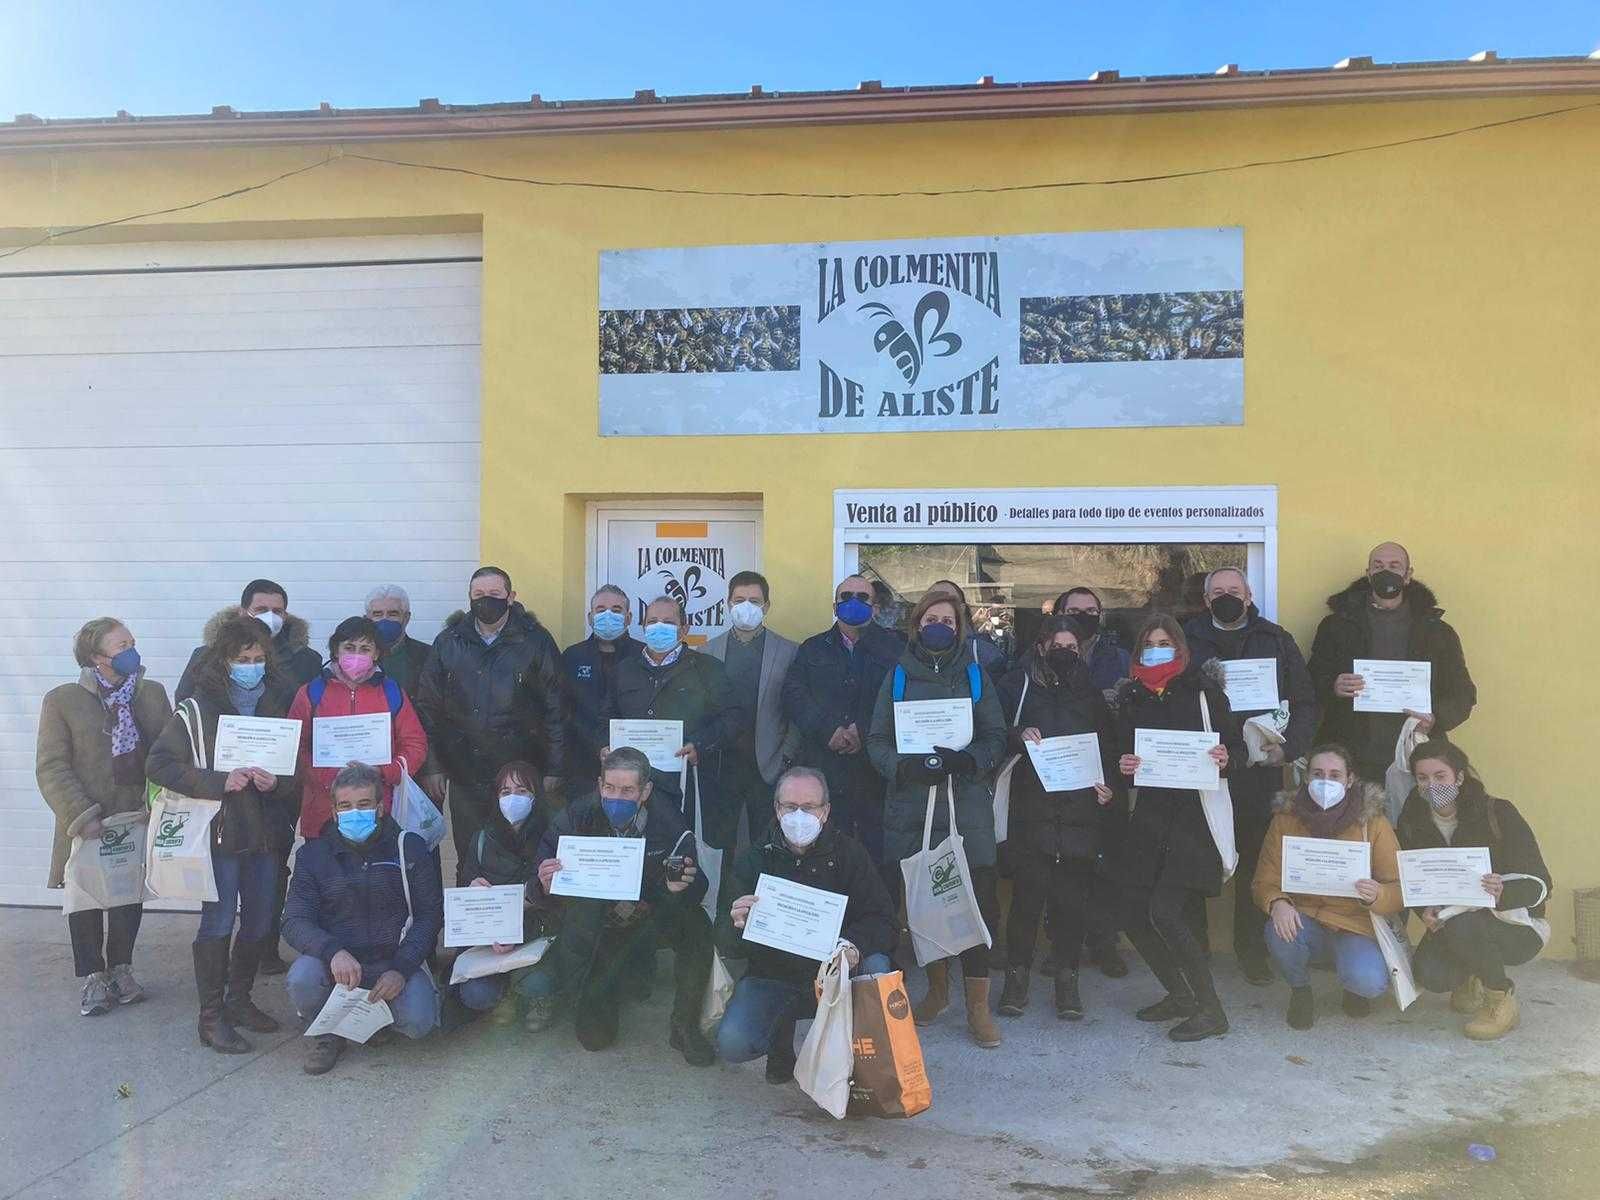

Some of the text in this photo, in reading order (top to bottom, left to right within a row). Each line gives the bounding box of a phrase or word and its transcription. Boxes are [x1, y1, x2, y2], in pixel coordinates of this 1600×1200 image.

[818, 251, 1001, 324] LA COLMENITA
[818, 355, 1000, 418] DE ALISTE
[846, 501, 1265, 526] Venta al público Detalles para todo tipo de eventos personalizados
[637, 547, 725, 580] LA COLMENITA
